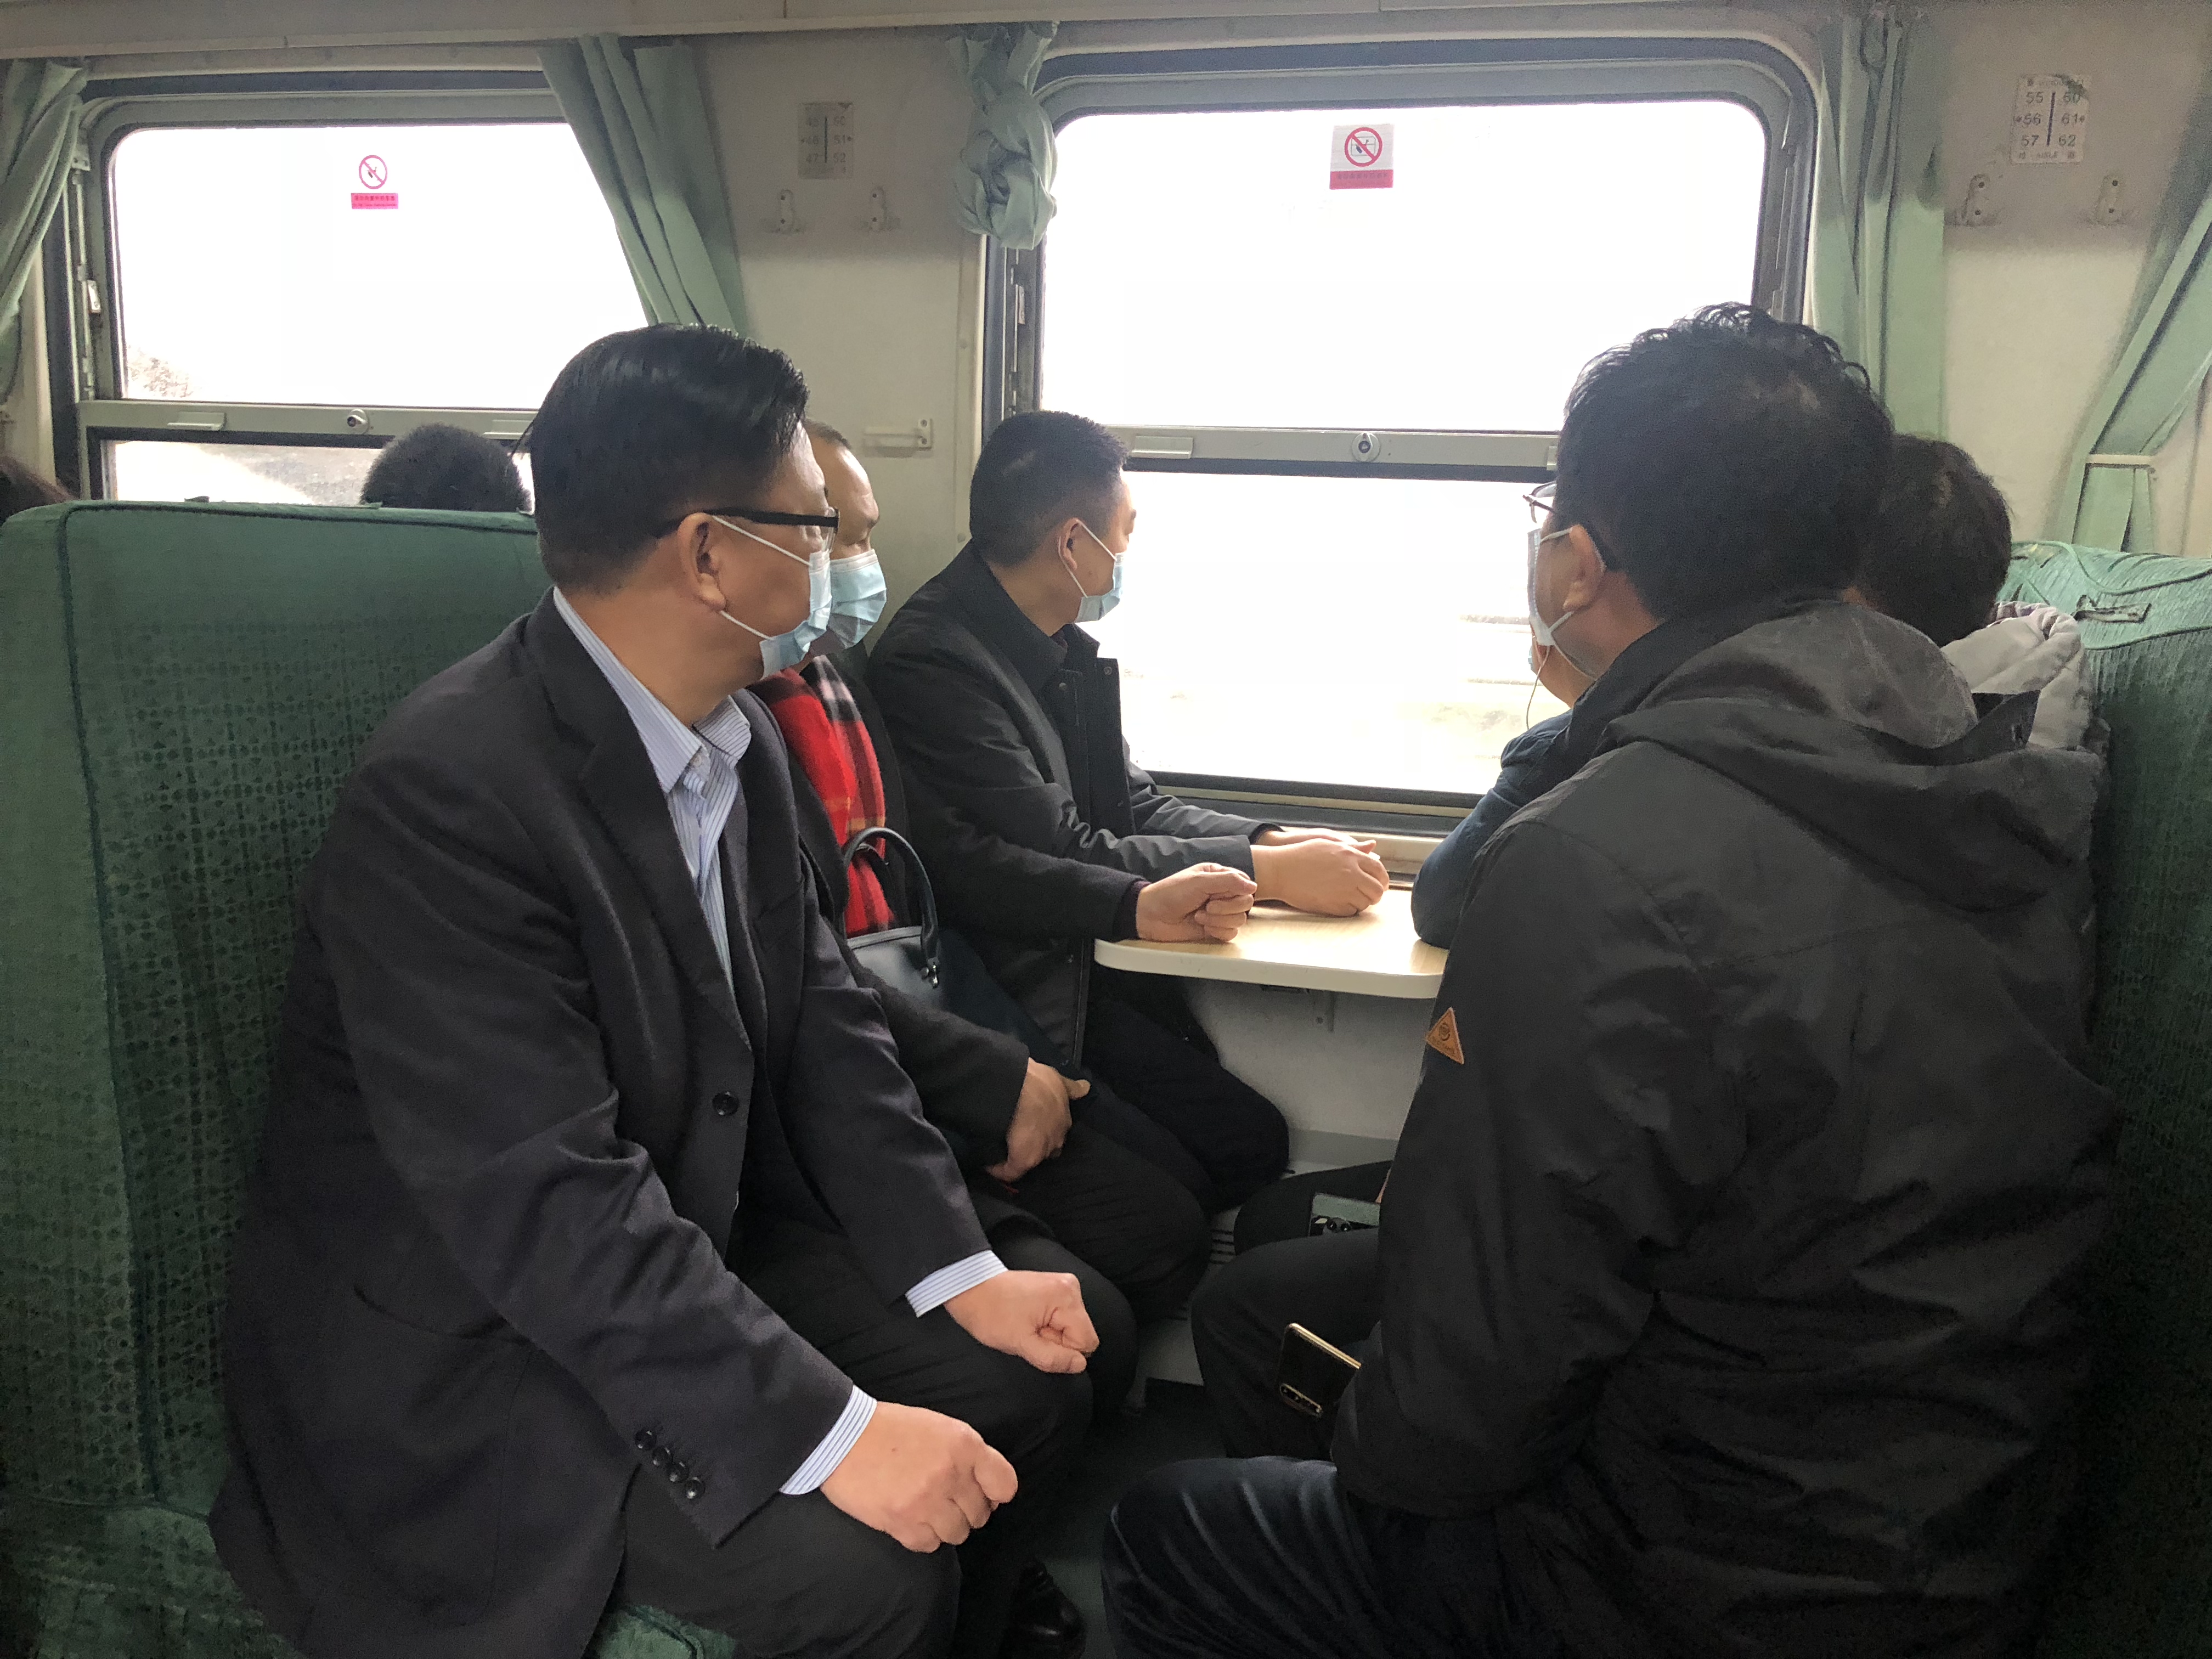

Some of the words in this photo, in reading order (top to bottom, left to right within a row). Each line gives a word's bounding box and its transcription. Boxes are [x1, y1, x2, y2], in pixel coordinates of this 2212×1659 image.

[2025, 91, 2044, 104] 55
[2023, 113, 2041, 126] 56
[2061, 113, 2078, 125] 61
[834, 134, 845, 144] 51
[2021, 134, 2039, 146] 57
[2058, 134, 2076, 147] 62
[833, 153, 846, 163] 52
